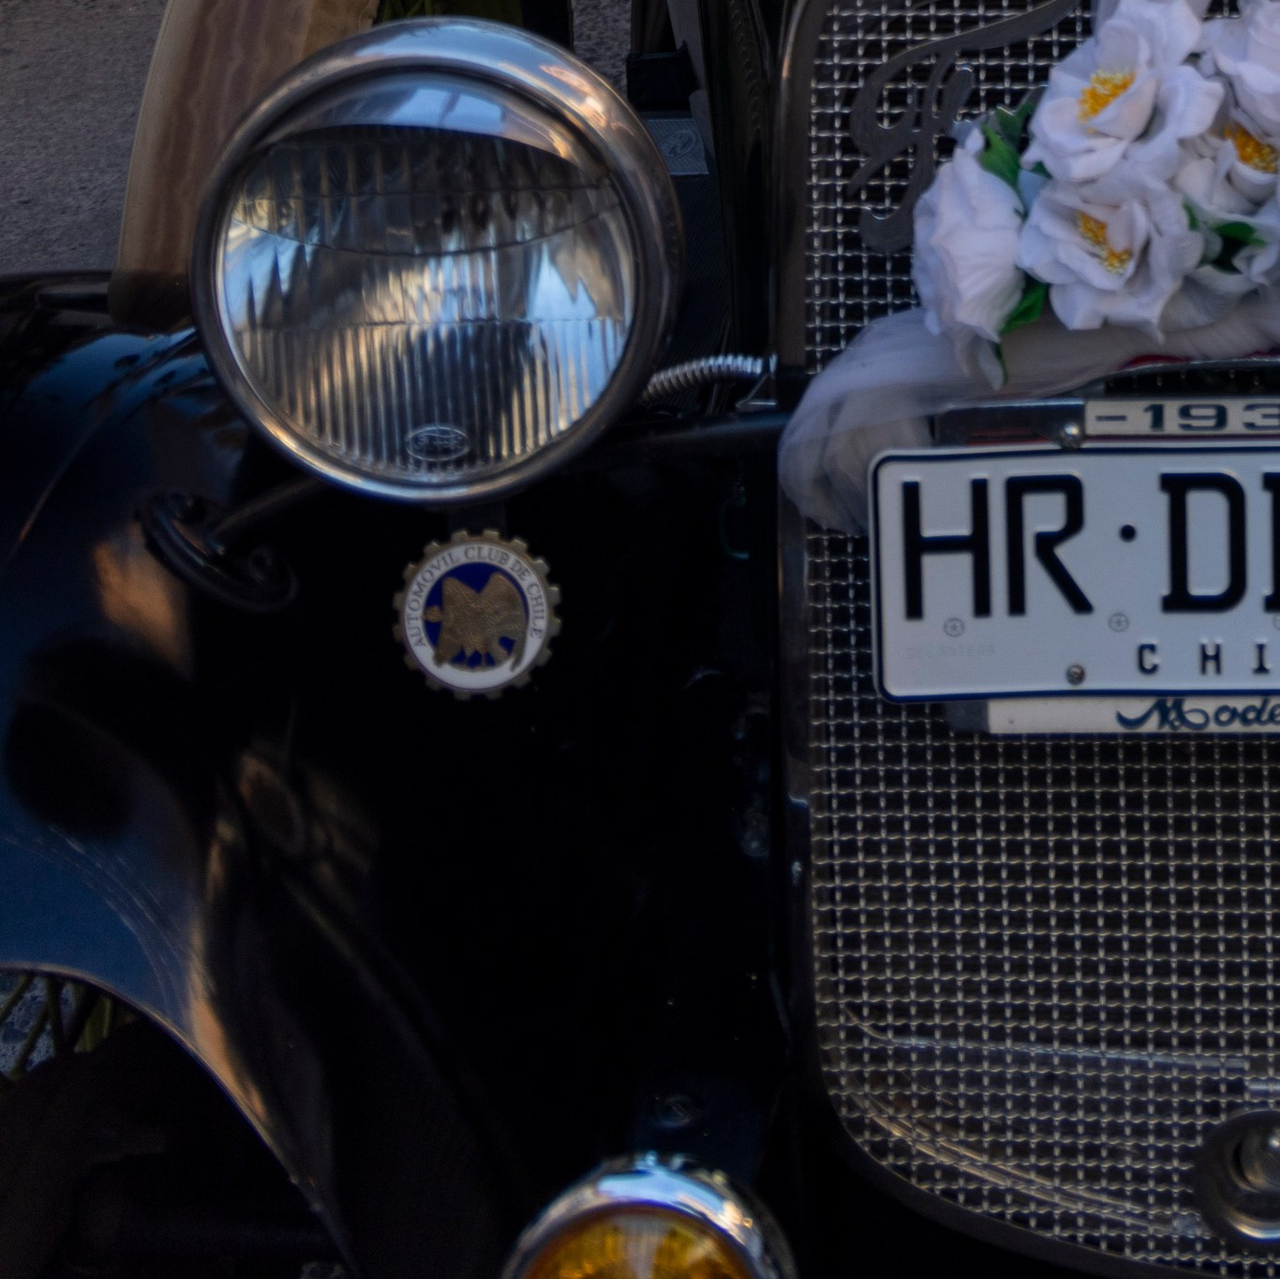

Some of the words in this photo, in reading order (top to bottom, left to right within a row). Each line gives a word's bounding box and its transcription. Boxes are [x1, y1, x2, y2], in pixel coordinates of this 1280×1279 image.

[406, 552, 460, 647] AUTOMOVIL
[464, 545, 510, 565] CLUB
[509, 558, 530, 582] DE
[526, 582, 545, 639] CHILE
